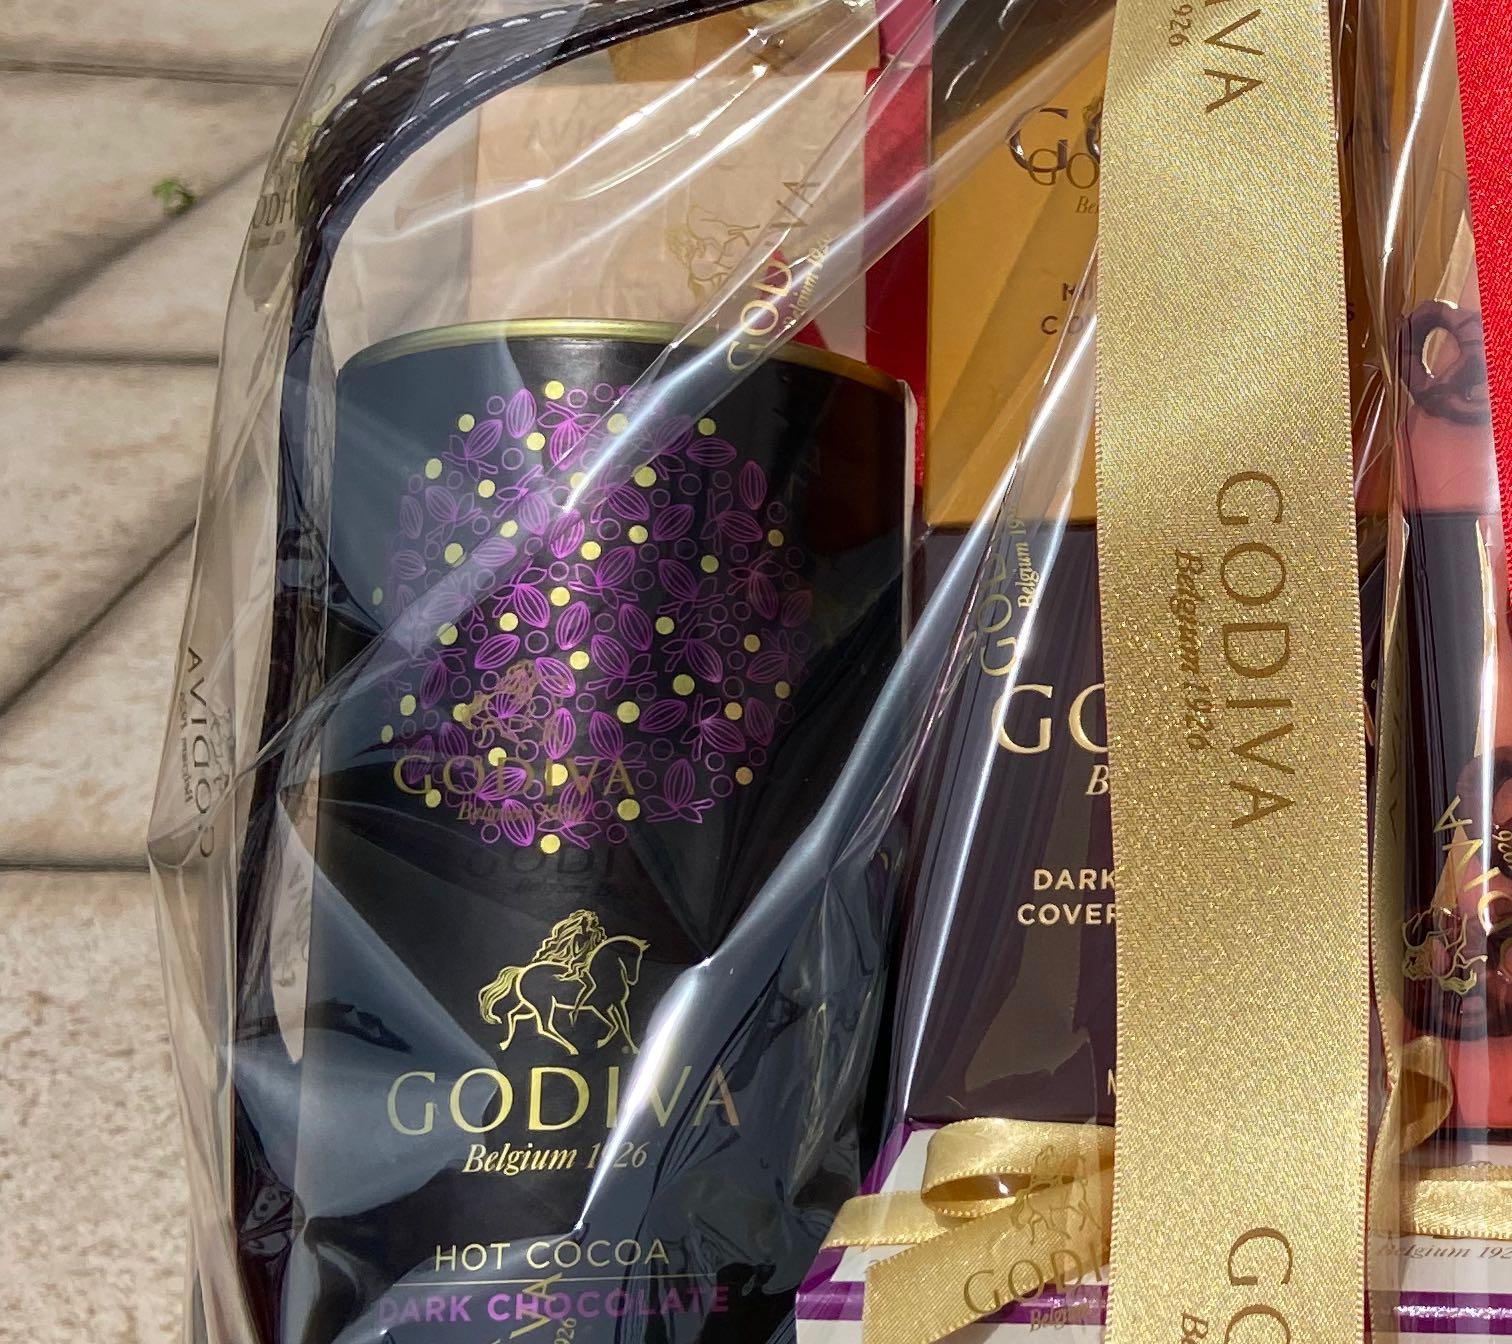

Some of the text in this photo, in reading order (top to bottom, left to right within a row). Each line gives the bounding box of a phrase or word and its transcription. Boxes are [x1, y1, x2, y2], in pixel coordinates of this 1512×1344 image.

[1216, 470, 1297, 829] GODIVA
[386, 1066, 740, 1136] GODIVA
[462, 1140, 647, 1176] Belgium 126
[434, 1238, 670, 1272] HOT COCOA
[377, 1285, 730, 1324] DARK CHOCOLATE
